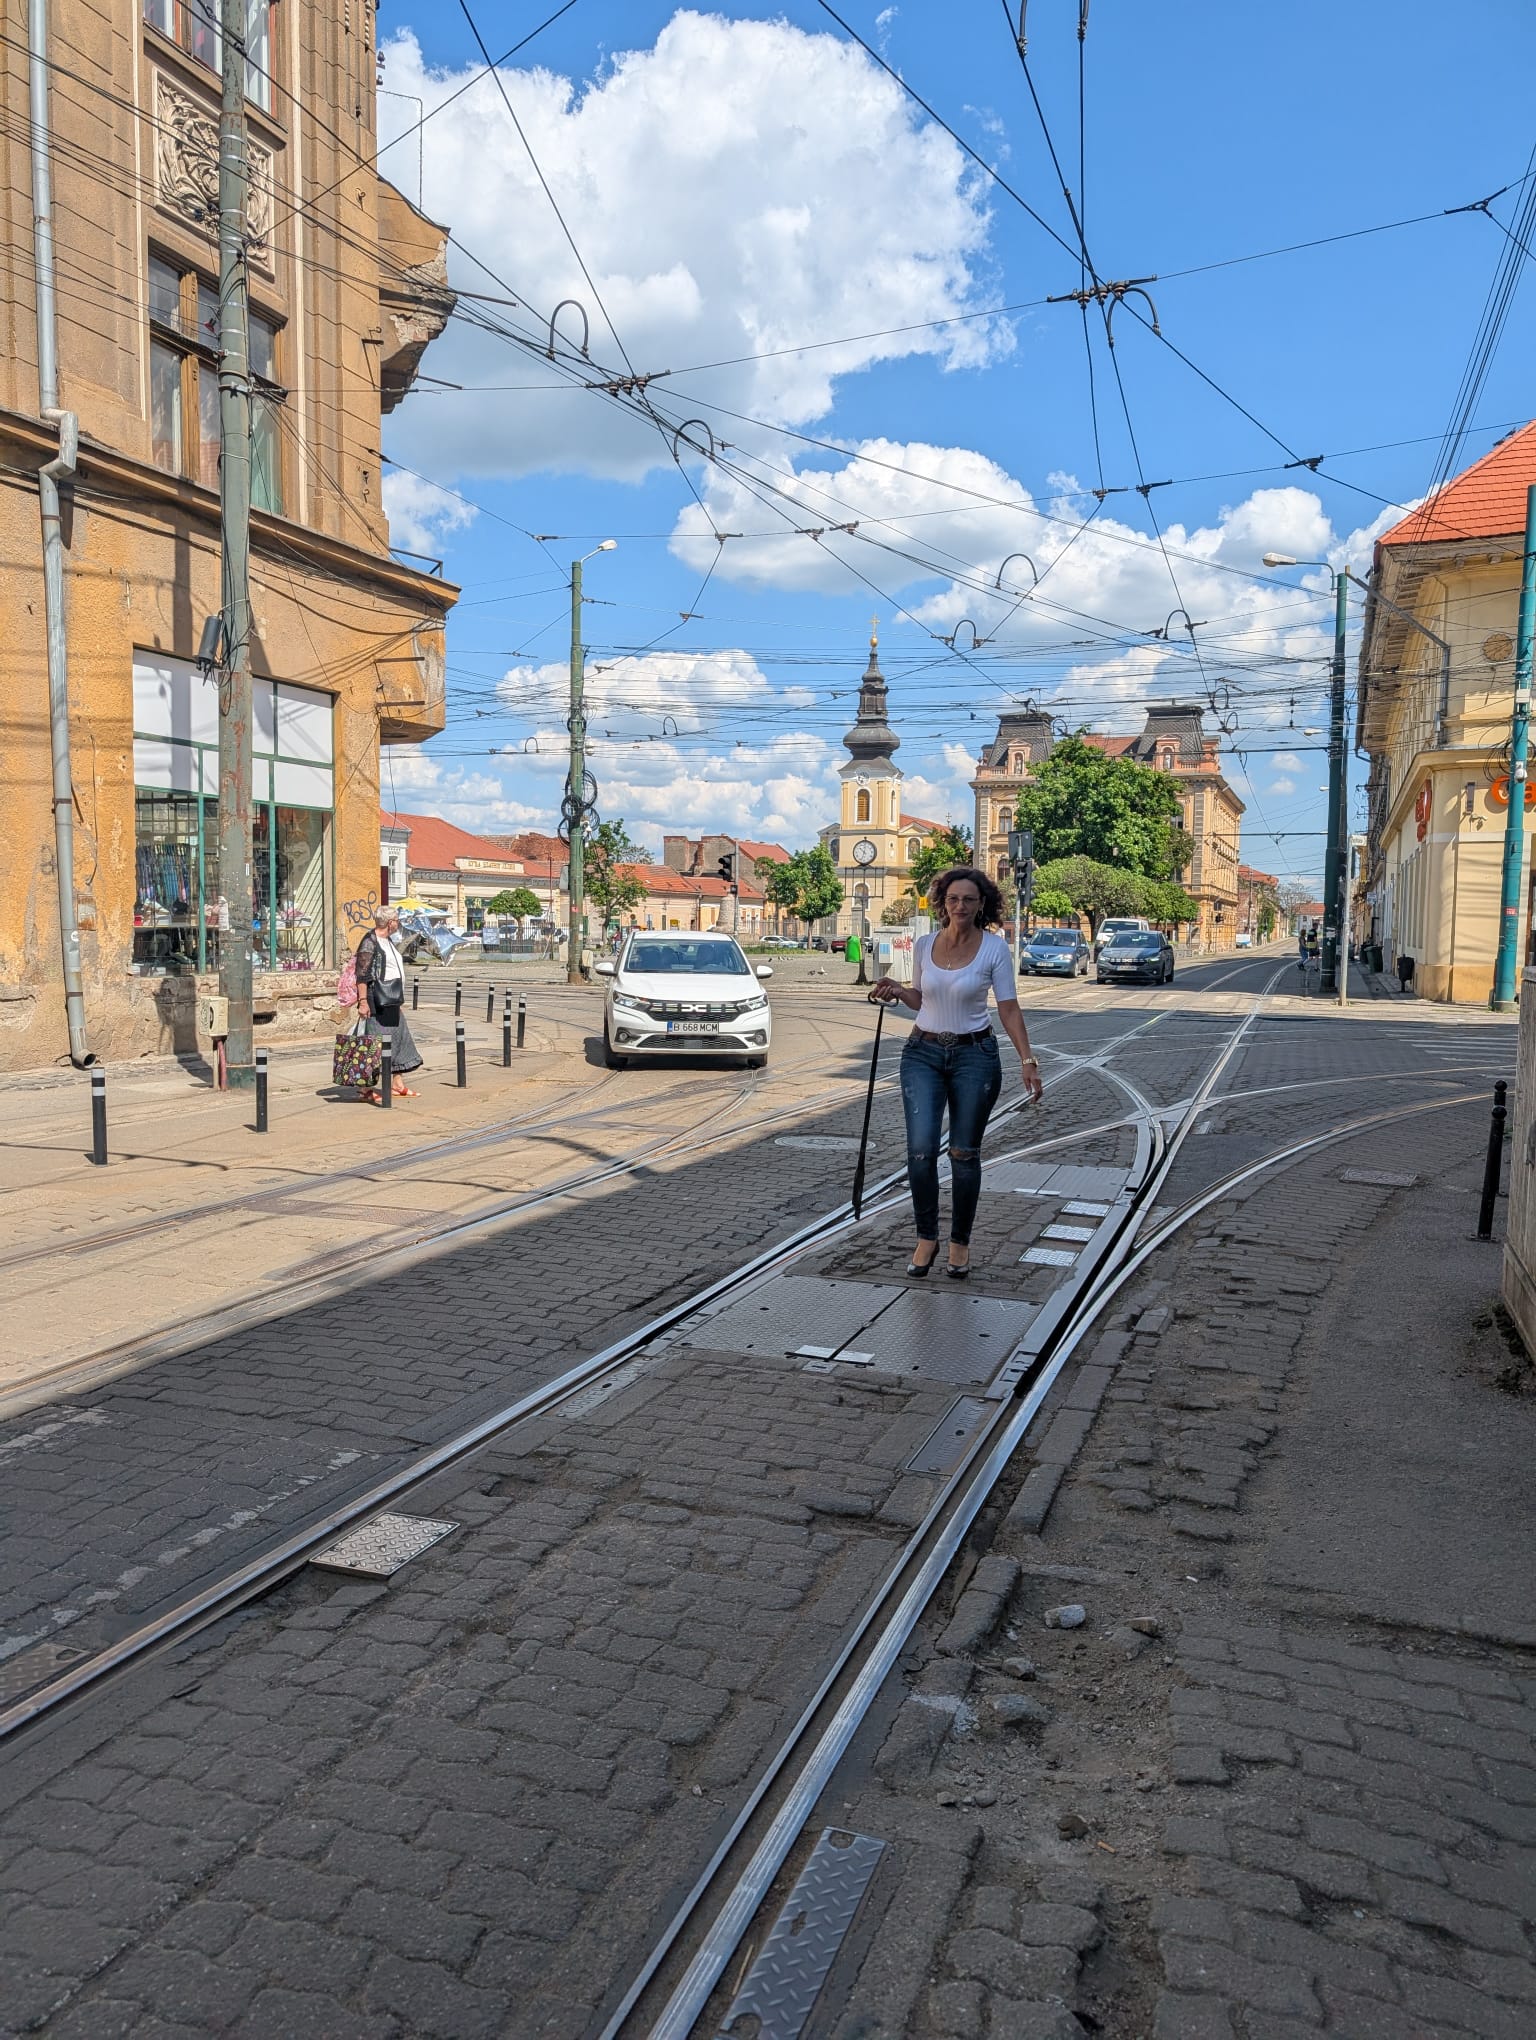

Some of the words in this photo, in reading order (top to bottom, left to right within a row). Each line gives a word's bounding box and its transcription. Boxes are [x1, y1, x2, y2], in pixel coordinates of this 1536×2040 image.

[673, 1023, 680, 1032] B
[682, 1023, 699, 1032] 668
[700, 1023, 718, 1032] MCM
